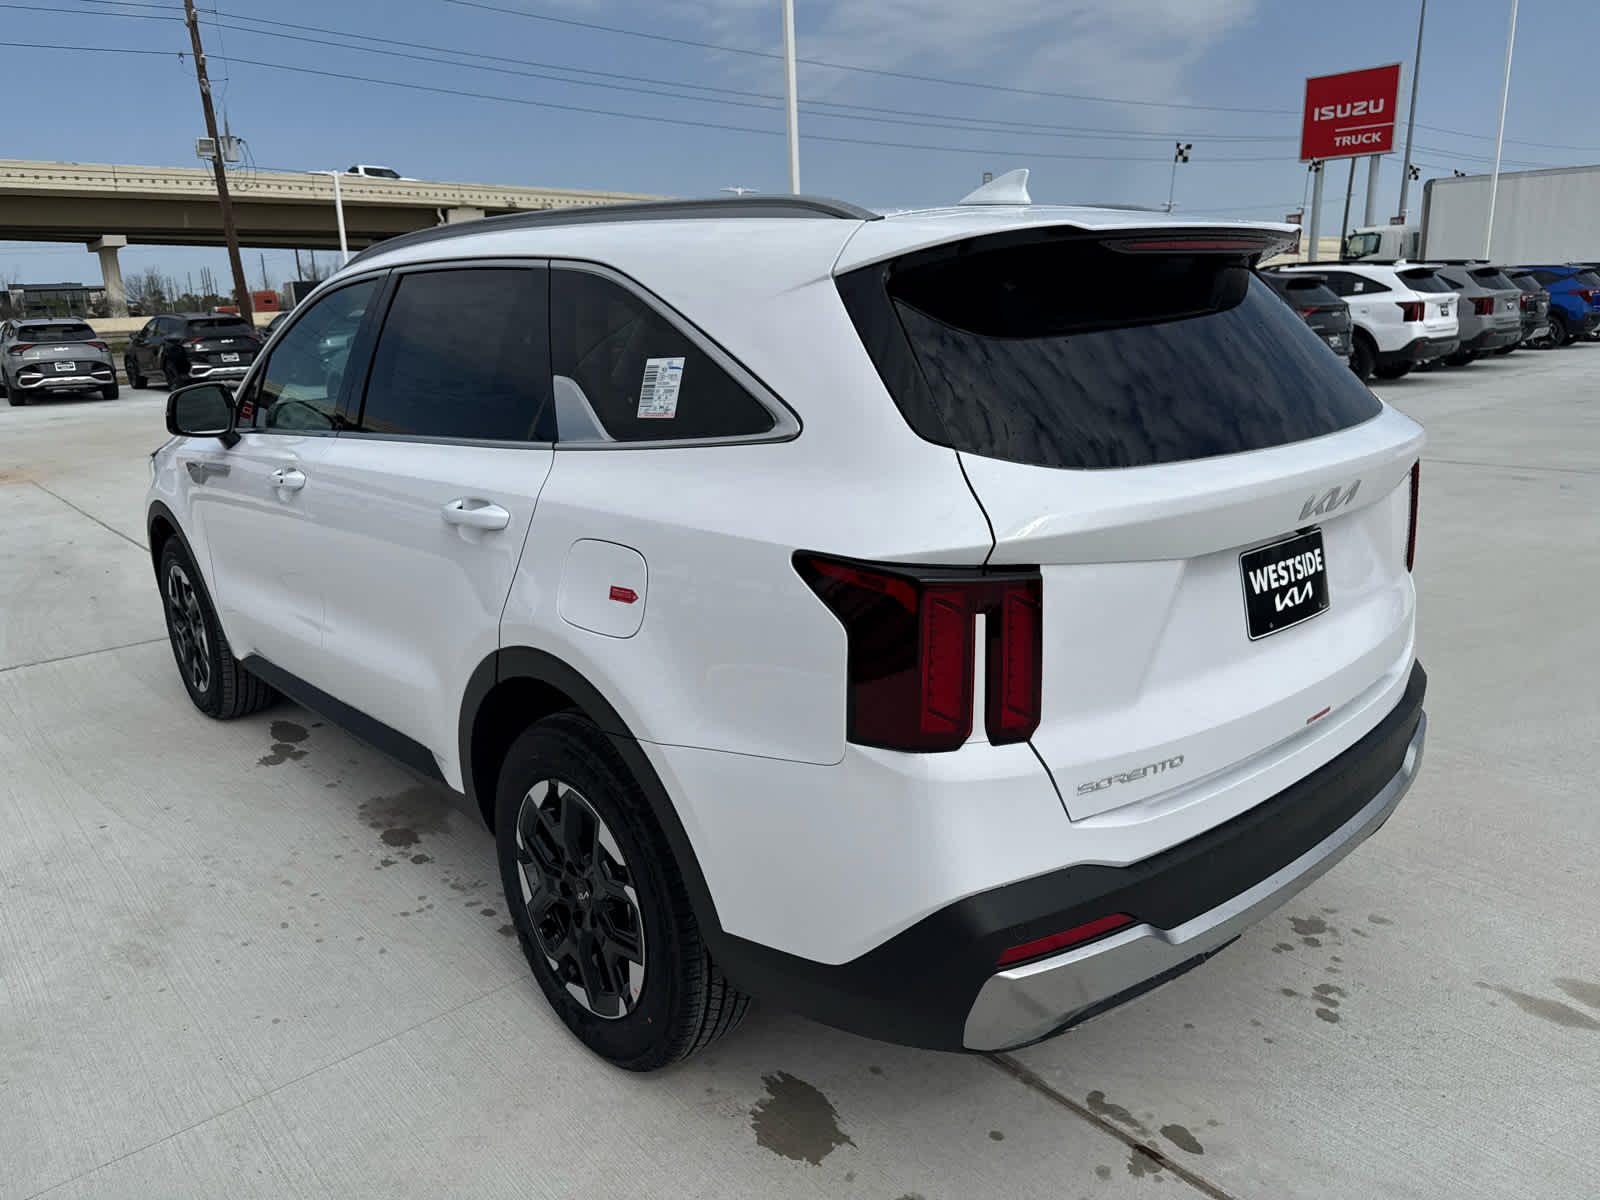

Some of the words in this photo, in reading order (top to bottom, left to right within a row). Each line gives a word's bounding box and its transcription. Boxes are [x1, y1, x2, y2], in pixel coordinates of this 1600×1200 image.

[1313, 98, 1385, 121] ISUZU
[1334, 132, 1382, 147] TRUCK
[1248, 547, 1324, 595] WESTSIDE
[1076, 754, 1184, 796] SORENTO
